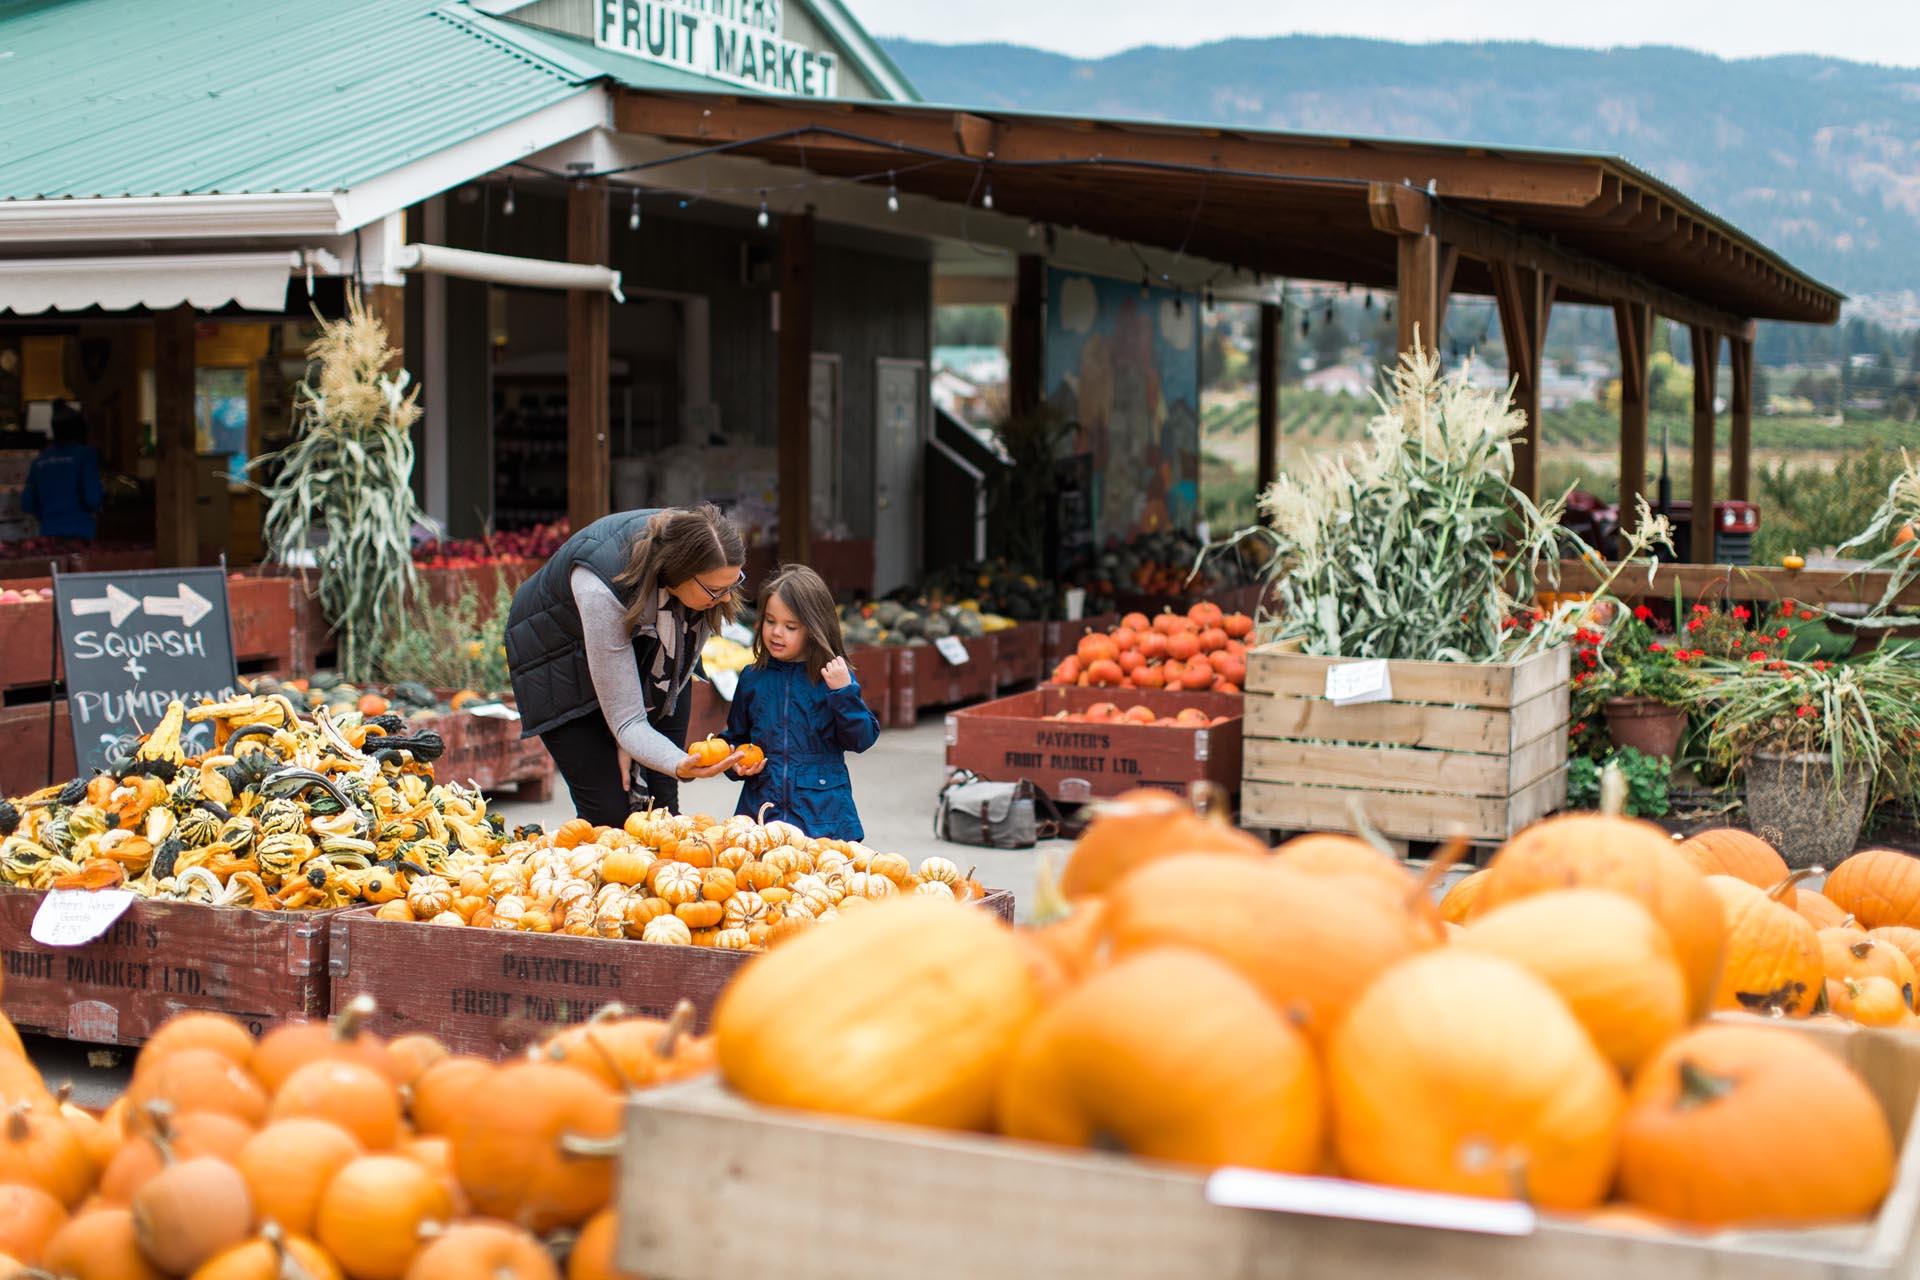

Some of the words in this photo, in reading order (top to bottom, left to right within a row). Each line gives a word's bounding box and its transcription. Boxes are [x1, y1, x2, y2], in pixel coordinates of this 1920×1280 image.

[601, 0, 697, 64] FRUIT
[715, 25, 834, 98] MARKET
[74, 630, 206, 659] SQUASH
[1037, 730, 1110, 749] PAYNTER'S
[1005, 752, 1043, 768] FRUIT
[1051, 755, 1105, 773] MARKET
[1112, 758, 1142, 775] LTD.
[67, 956, 150, 989] MARKET
[163, 966, 207, 997] LTD.
[502, 953, 622, 988] PAYNTER'S
[451, 988, 511, 1018] FRUIT
